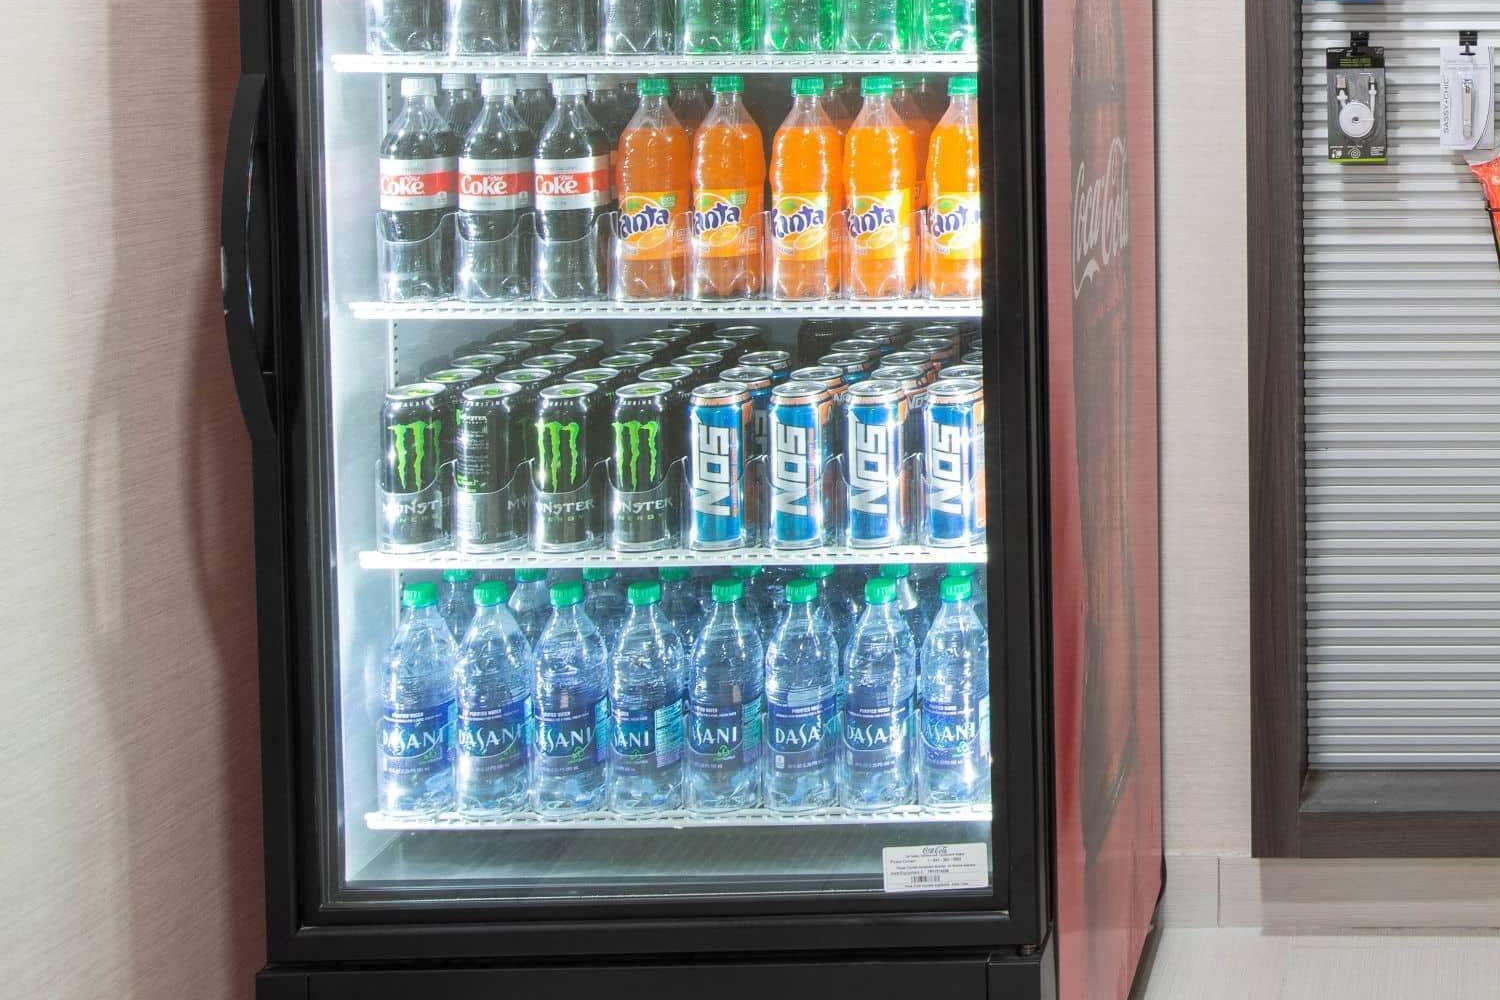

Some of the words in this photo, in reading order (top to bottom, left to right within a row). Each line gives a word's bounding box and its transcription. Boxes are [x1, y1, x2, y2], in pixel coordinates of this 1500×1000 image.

[381, 175, 424, 195] Coke
[462, 175, 507, 195] Coke
[535, 175, 578, 195] Coke
[617, 204, 669, 241] anta
[693, 202, 741, 237] anta
[694, 422, 731, 516] NOS
[775, 422, 808, 516] NOS
[851, 421, 889, 515] NOS
[930, 421, 965, 515] NOS
